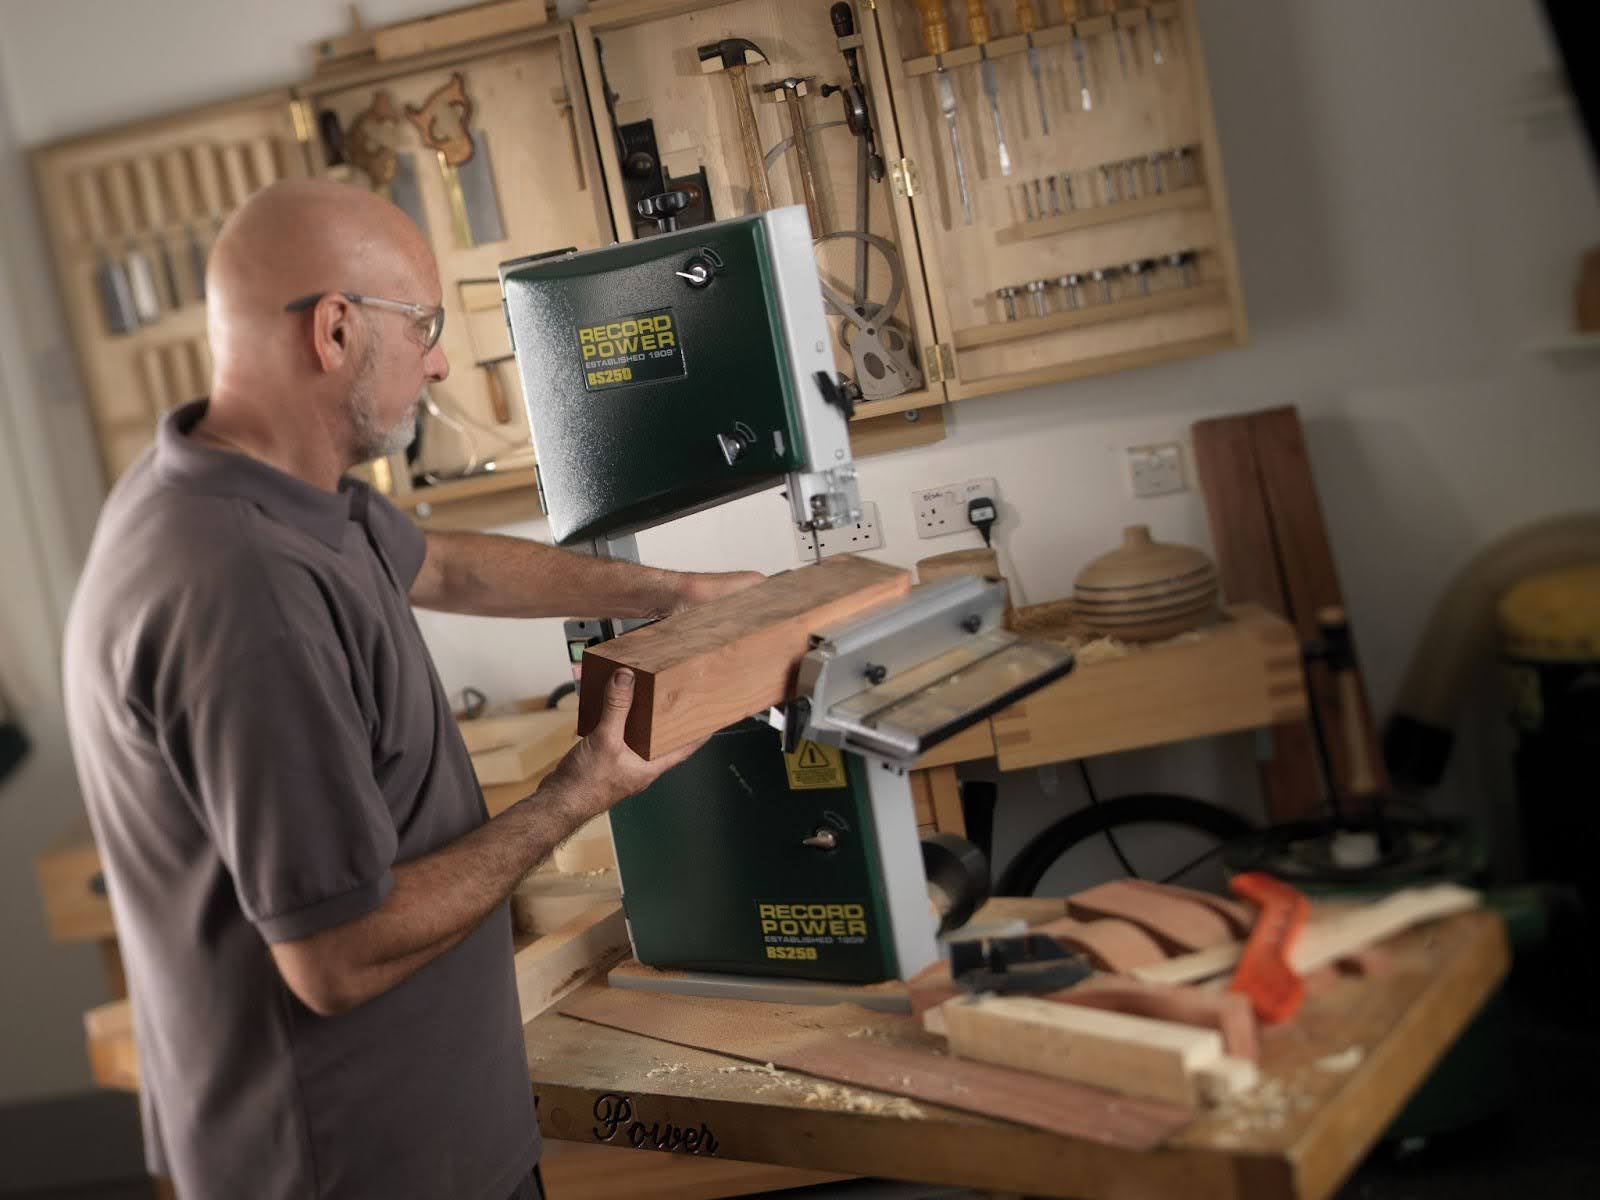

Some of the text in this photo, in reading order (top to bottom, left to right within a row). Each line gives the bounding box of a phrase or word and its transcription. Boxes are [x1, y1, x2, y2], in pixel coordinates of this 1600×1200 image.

[579, 315, 672, 344] RECORD
[582, 331, 676, 360] POWER
[585, 353, 646, 369] ESTABLISHED
[587, 367, 633, 386] BS250
[759, 903, 864, 919] RECORD
[761, 919, 867, 935] POWER
[592, 1092, 719, 1156] Power
